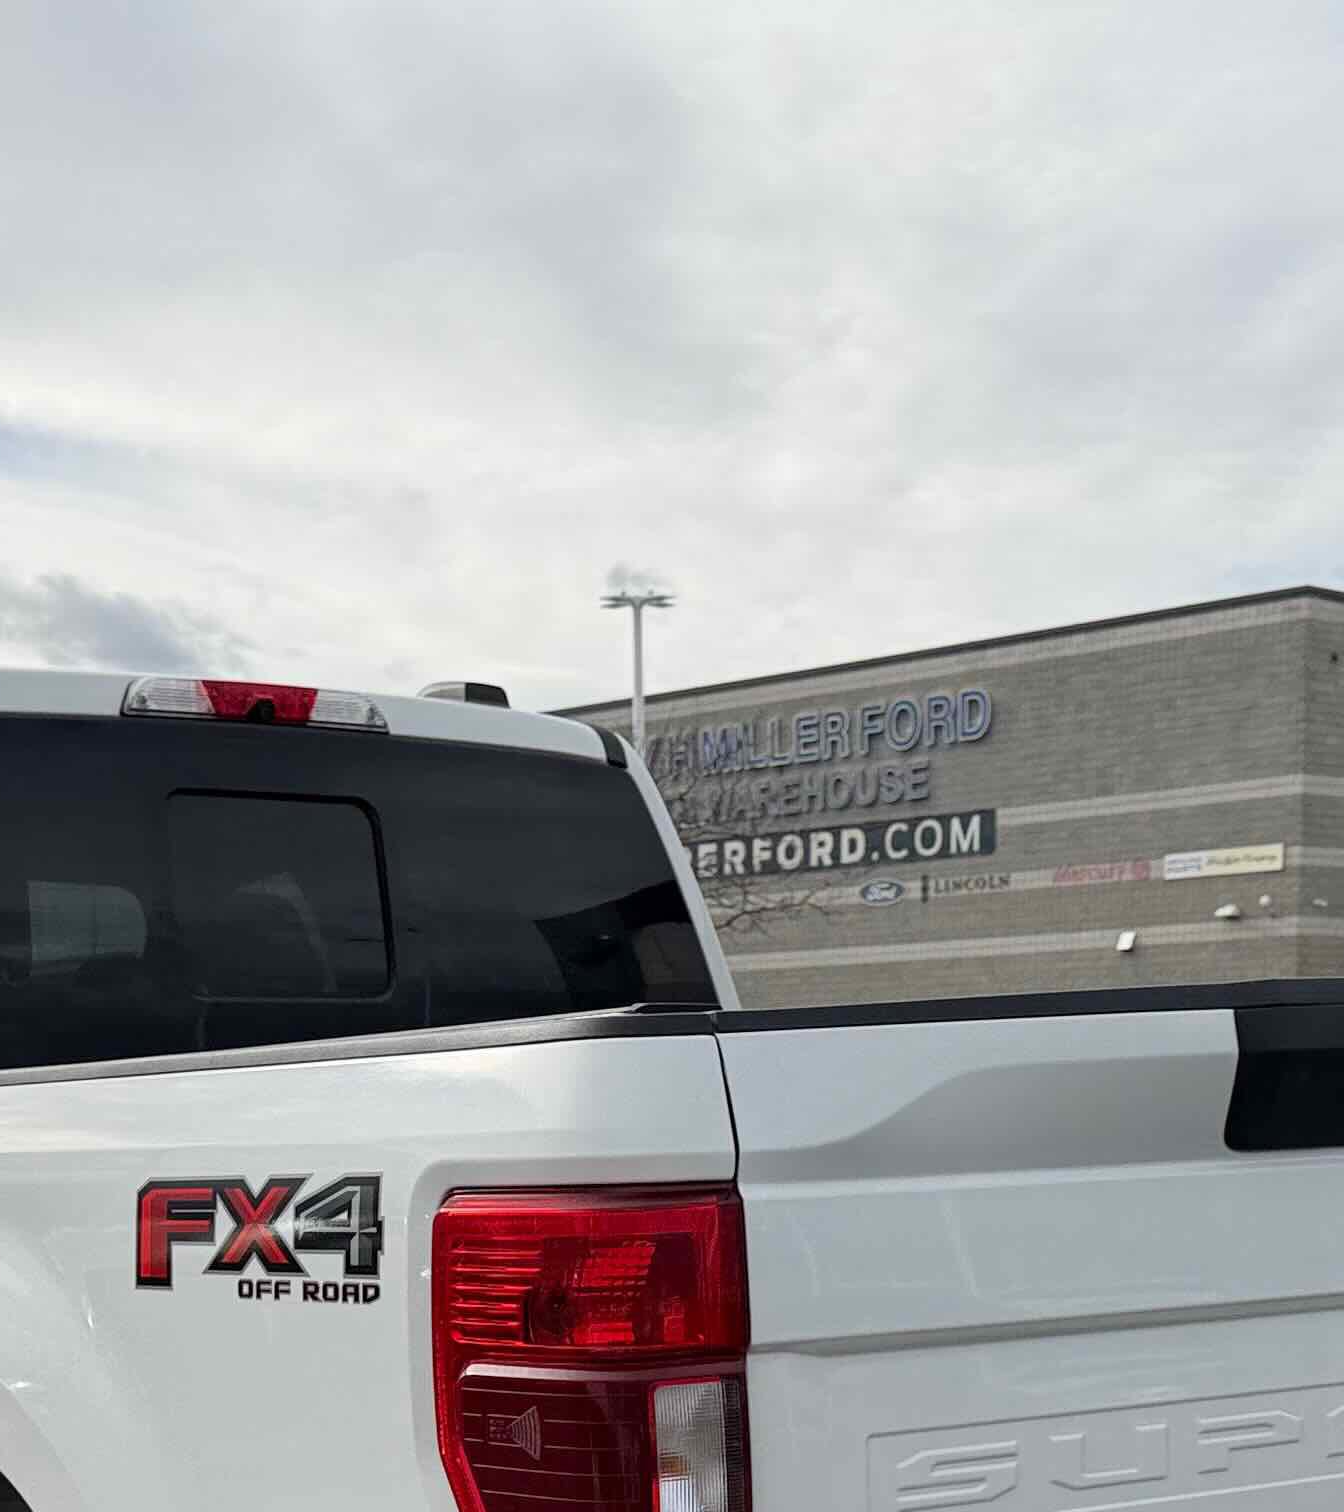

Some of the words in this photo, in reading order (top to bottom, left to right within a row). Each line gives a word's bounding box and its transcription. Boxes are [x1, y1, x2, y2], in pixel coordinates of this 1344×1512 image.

[700, 706, 851, 776] MILLER
[858, 687, 993, 757] FORD
[709, 758, 931, 823] WAREHOUSE
[688, 814, 982, 878] ERFORD.COM
[135, 1173, 384, 1290] FX4
[237, 1279, 292, 1301] OFF
[302, 1280, 382, 1305] ROAD
